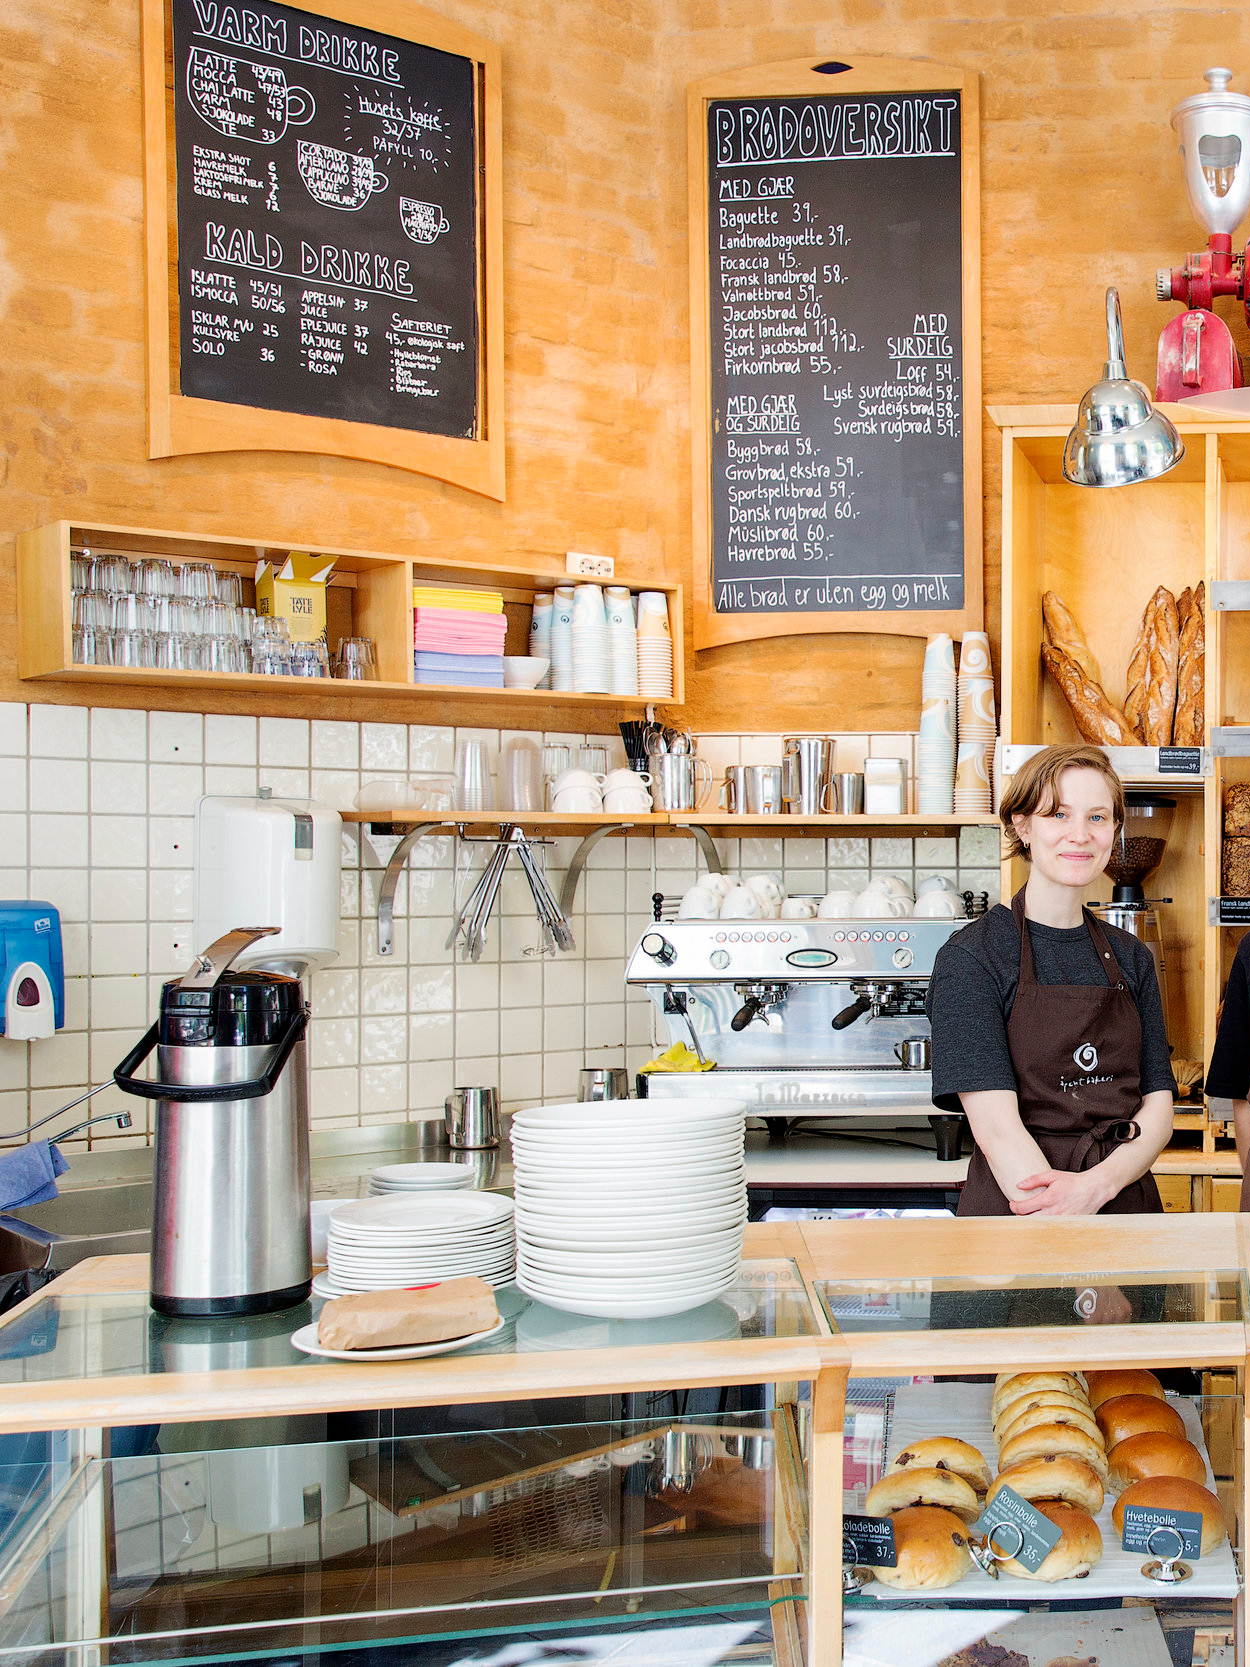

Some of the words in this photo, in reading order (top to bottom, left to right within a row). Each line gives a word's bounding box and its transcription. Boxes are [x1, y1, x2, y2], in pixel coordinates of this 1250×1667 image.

[192, 0, 287, 53] VARM
[300, 26, 400, 81] DRIKKE
[195, 51, 237, 73] LATTE
[252, 65, 282, 83] 43/49
[194, 64, 237, 86] MOCCA
[258, 80, 286, 98] 47/53
[192, 78, 219, 95] CHAI
[223, 86, 255, 103] LATTE
[268, 97, 284, 109] 43
[195, 91, 231, 110] VARM
[266, 107, 282, 121] 48
[201, 104, 255, 127] SJOKOLADE
[359, 96, 404, 120] Husets
[410, 106, 442, 131] kaffe
[218, 120, 237, 135] TE
[261, 128, 276, 141] 33
[382, 119, 422, 142] 32/37
[716, 98, 957, 164] BRØDOVERSIKT
[193, 144, 227, 161] EKSTRA
[228, 153, 251, 167] SHOT
[268, 161, 277, 172] 6
[301, 143, 347, 163] CORTADO
[373, 135, 414, 158] PÅFYLL
[193, 157, 247, 178] HAVREMELK
[268, 172, 278, 182] 7
[300, 153, 349, 174] AMERICANO
[301, 165, 350, 185] CAPPUCCINO
[193, 176, 222, 190] KREM
[269, 192, 277, 201] 6
[193, 185, 222, 199] GLASS
[223, 192, 249, 205] MELK
[265, 200, 281, 212] 12
[269, 182, 279, 194] 7
[308, 178, 343, 193] BARNE-
[353, 188, 366, 199] 36
[312, 188, 357, 206] SJOKOLADE
[719, 178, 751, 199] MED
[757, 175, 795, 197] GJÆR
[403, 200, 435, 216] ESPRESSO
[719, 205, 779, 234] Baguette
[792, 202, 819, 223] 39,-
[719, 227, 824, 252] Landbrødbaguette
[828, 224, 852, 247] 39,-
[206, 222, 283, 269] KALD
[301, 240, 414, 294] DRIKKE
[720, 252, 769, 271] Focaccia
[778, 252, 802, 269] 45,-
[191, 269, 236, 288] ISLATTE
[250, 279, 282, 297] 45/51
[721, 272, 760, 288] Fransk
[764, 266, 817, 285] landbrød
[823, 264, 849, 285] 58,-
[191, 284, 239, 306] ISMOCCA
[251, 295, 286, 314] 50/56
[797, 284, 823, 302] 59,-
[300, 304, 328, 318] JUICE
[354, 298, 369, 312] 37
[722, 303, 798, 323] Jacobsbrød
[804, 302, 827, 320] 60,-
[192, 310, 229, 328] ISKLAR
[262, 323, 279, 338] 25
[193, 324, 240, 342] KULLSYRE
[301, 318, 348, 336] EPLEJUICE
[354, 325, 370, 338] 37
[390, 312, 452, 335] SAFTERIET
[723, 323, 755, 341] Stort
[758, 321, 808, 339] landbrød
[813, 317, 847, 337] 112,-
[913, 313, 948, 334] MED
[192, 338, 225, 356] SOLO
[260, 348, 275, 362] 36
[301, 332, 342, 350] RÅJUICE
[354, 341, 368, 355] 42
[385, 331, 406, 346] 45,-
[446, 341, 465, 353] saft
[723, 341, 755, 358] Stort
[760, 335, 824, 359] jacobsbrød
[832, 333, 865, 353] 112,-
[886, 336, 953, 357] SURDEIG
[308, 348, 344, 364] GRØNN
[810, 356, 843, 375] 55,-
[308, 361, 337, 376] ROSA
[897, 361, 927, 383] Loff
[936, 363, 960, 383] 54,-
[726, 395, 757, 415] MED
[760, 394, 798, 414] GJÆR
[823, 382, 853, 408] Lyst
[858, 381, 933, 403] surdeigsbrød
[936, 385, 960, 402] 58,-
[936, 402, 960, 420] 58,-
[726, 416, 743, 432] OG
[747, 415, 800, 432] SURDEIG
[833, 416, 878, 435] Svensk
[880, 417, 932, 442] rugbrød
[936, 419, 961, 438] 59,-
[727, 438, 789, 463] Byggbrød
[795, 437, 821, 456] 58,-
[725, 462, 789, 483] Grovbrød,
[790, 461, 831, 479] ekstra
[834, 456, 864, 477] 59,-
[728, 482, 822, 506] Sportspeltbrød
[828, 481, 855, 499] 59,-
[729, 504, 771, 523] Dansk
[775, 501, 828, 526] rugbrød
[834, 501, 861, 520] 60,-
[728, 524, 799, 543] Müslibrød
[807, 524, 834, 541] 60,-
[728, 542, 797, 562] Havrebrød
[803, 542, 834, 561] 55,-
[717, 584, 746, 609] Alle
[750, 577, 788, 607] brød
[794, 587, 811, 604] er
[816, 576, 854, 604] uten
[860, 585, 886, 609] egg
[892, 585, 910, 608] og
[913, 576, 950, 603] melk
[999, 1490, 1038, 1528] Rosinbolle
[1126, 1511, 1176, 1526] Hvetebolle
[843, 1520, 891, 1535] oladebolle
[877, 1546, 894, 1559] 37,-
[1024, 1545, 1041, 1563] 35,-
